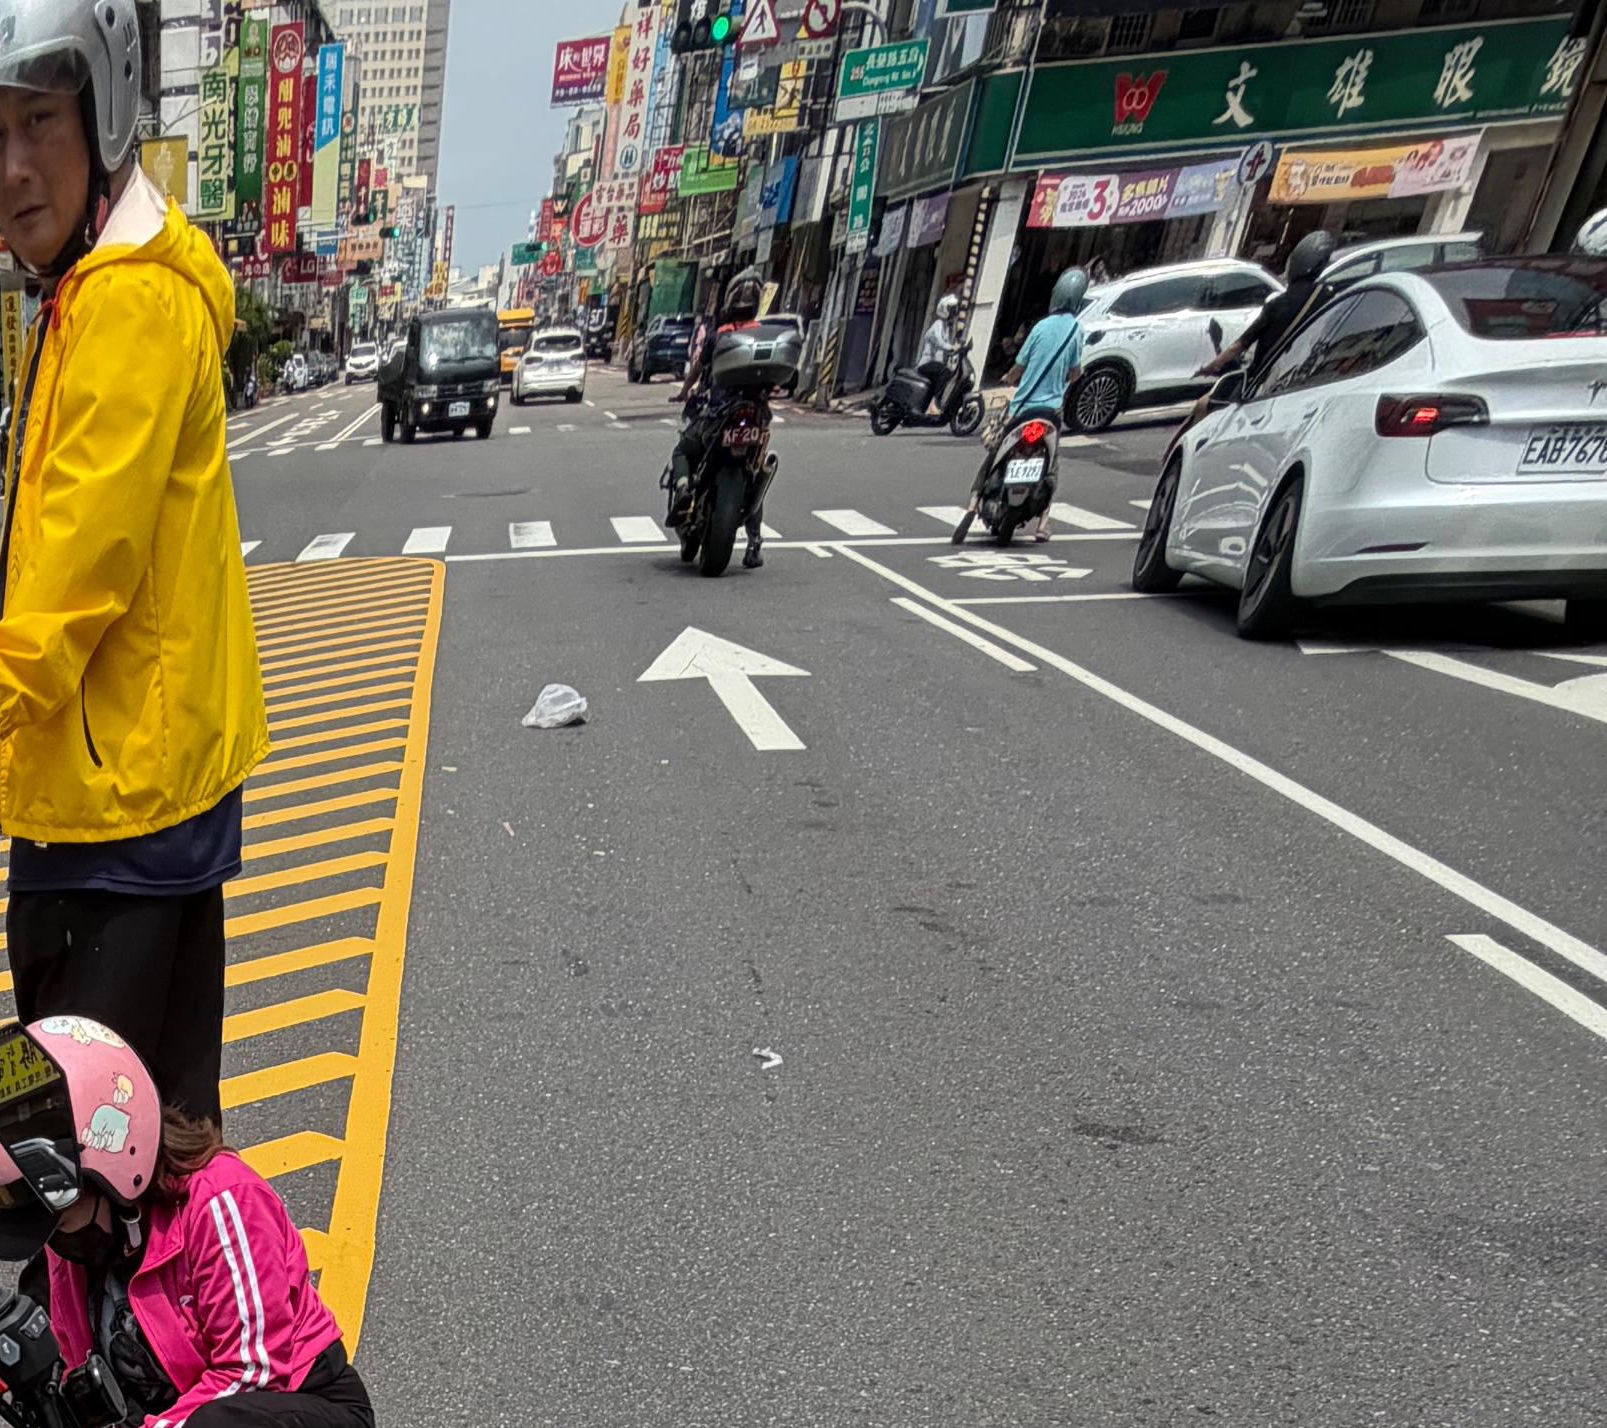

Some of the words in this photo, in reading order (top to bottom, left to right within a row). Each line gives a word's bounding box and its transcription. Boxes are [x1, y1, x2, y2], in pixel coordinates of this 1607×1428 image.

[1212, 34, 1587, 128] 文雄眼鏡
[200, 72, 227, 209] 南光牙醫
[300, 259, 315, 274] LG
